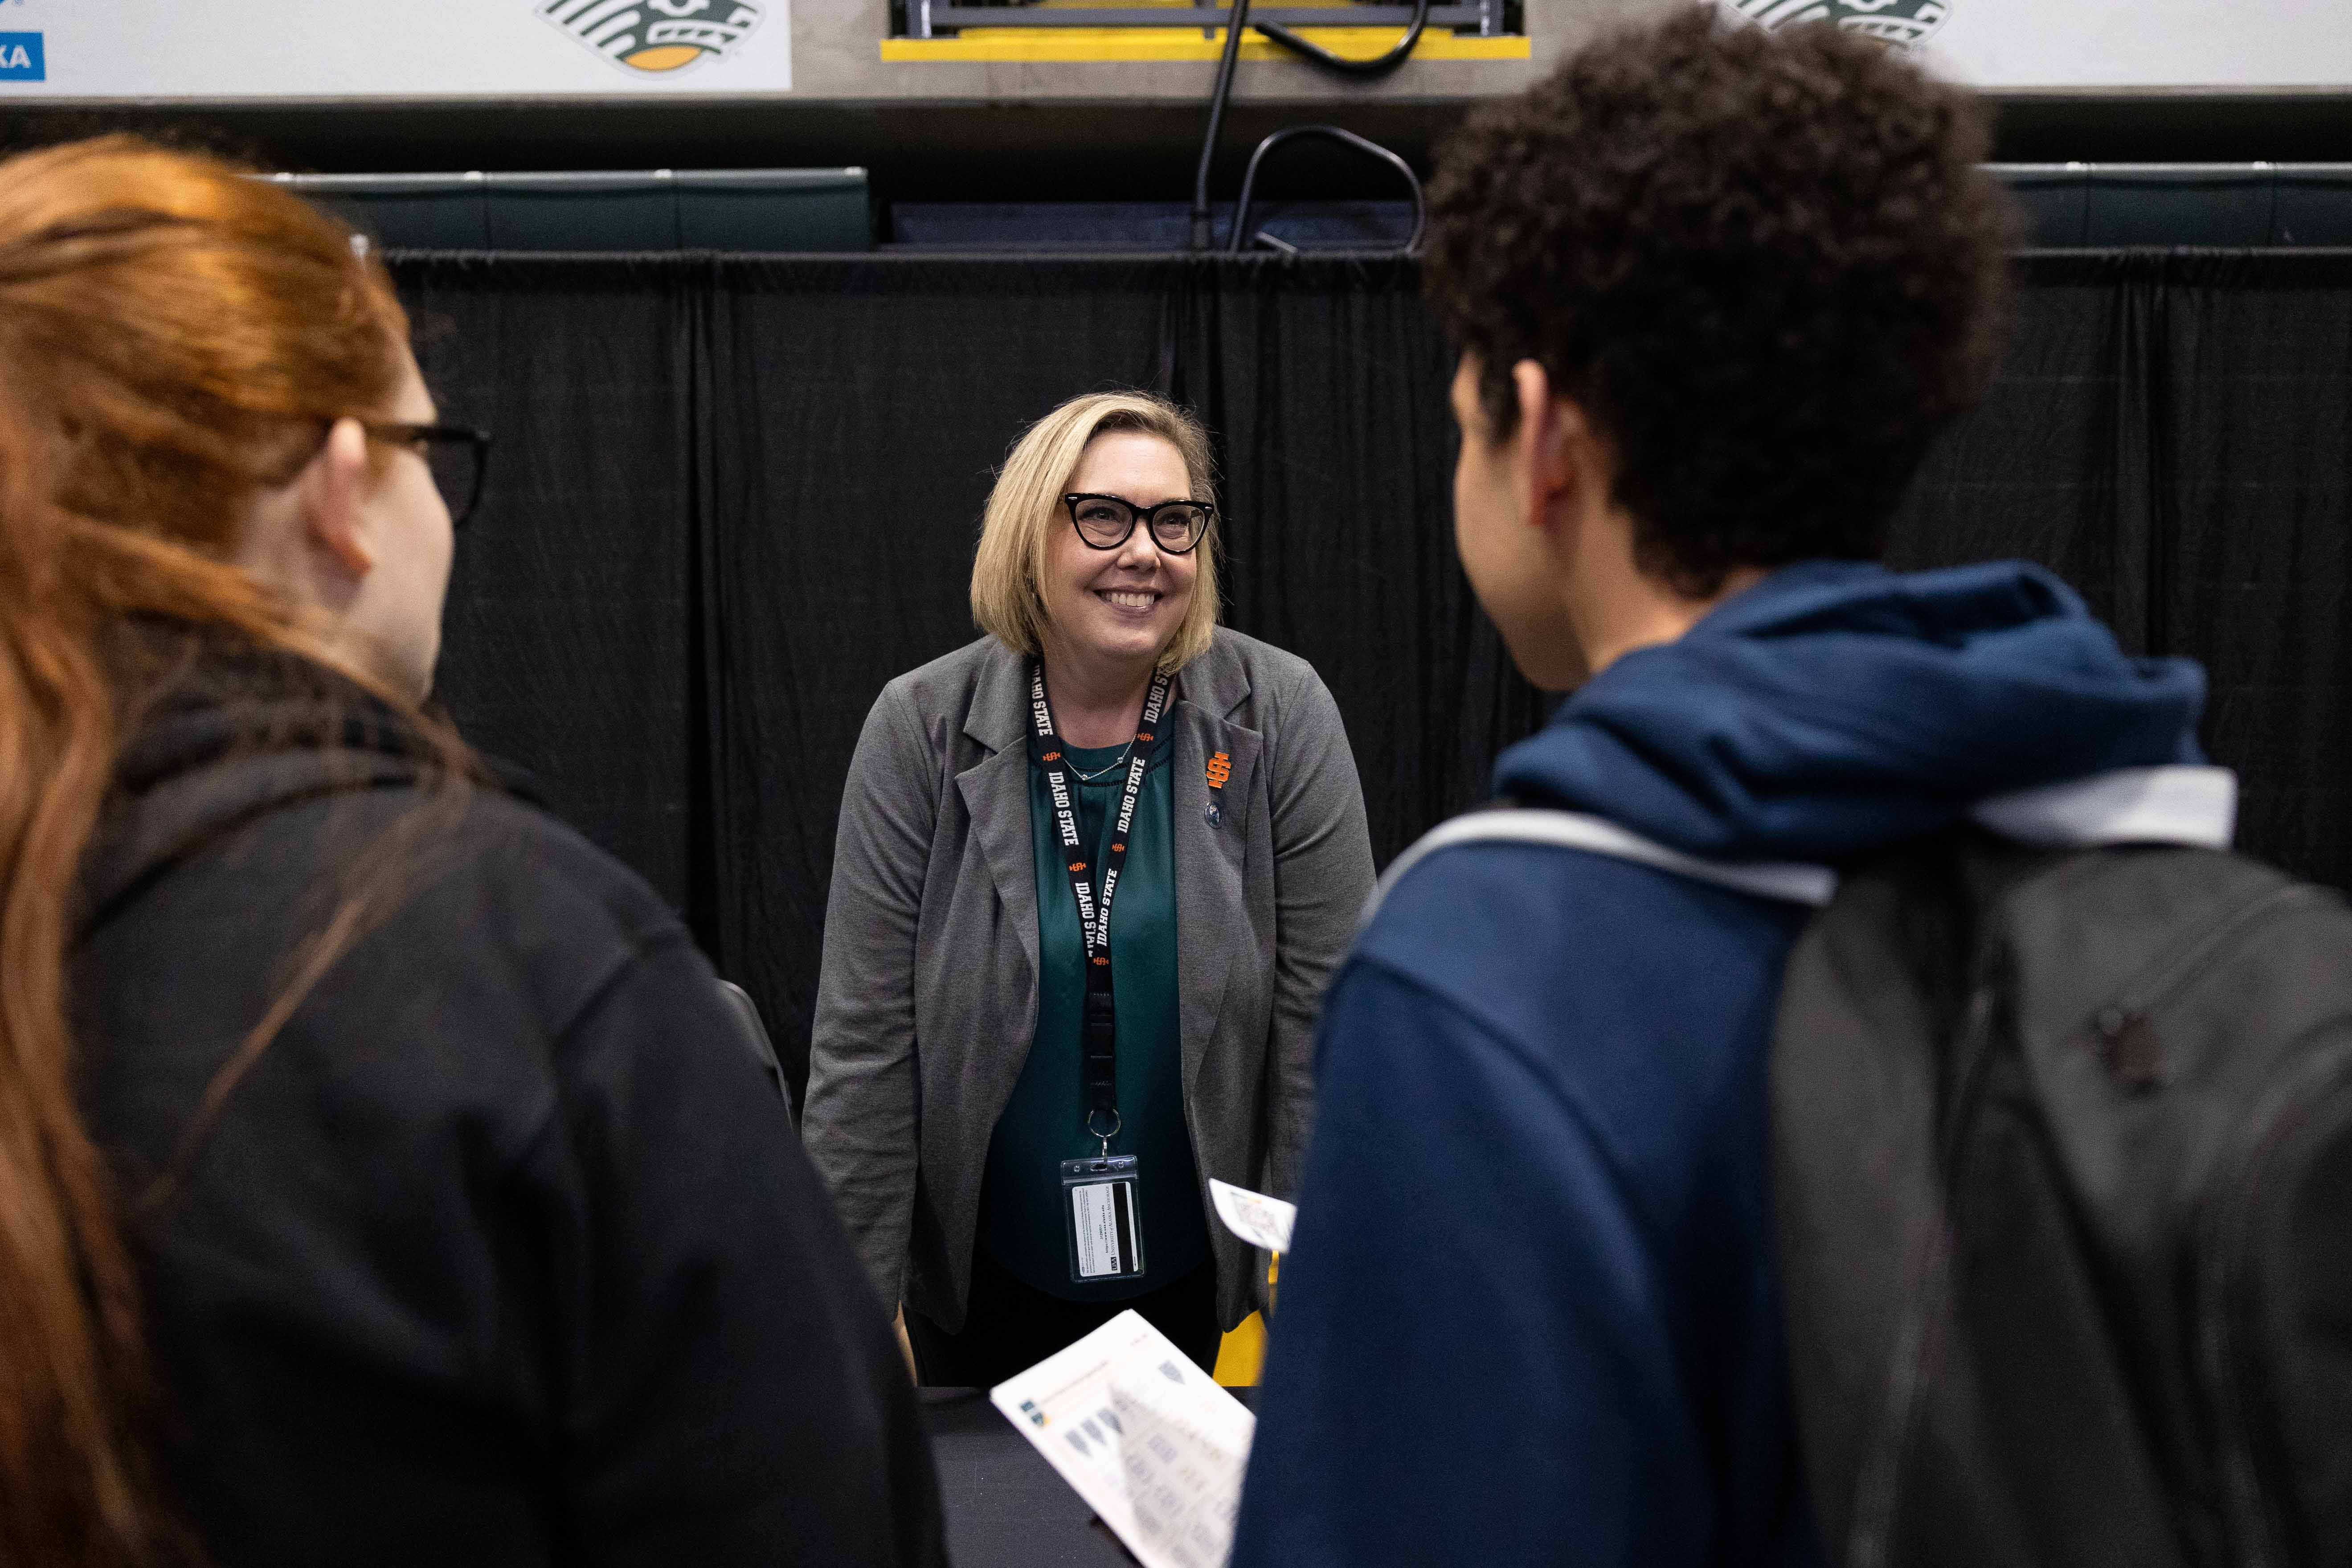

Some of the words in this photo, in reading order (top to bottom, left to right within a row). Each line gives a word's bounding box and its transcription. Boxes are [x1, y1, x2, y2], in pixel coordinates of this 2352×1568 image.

[1033, 701, 1054, 736] STATE
[1144, 685, 1165, 724] IDAHO
[1048, 772, 1069, 808] IDAHO
[1117, 795, 1135, 833] IDAHO
[1126, 757, 1145, 794] STATE
[1058, 810, 1079, 846] STATE
[1075, 882, 1095, 919] IDAHO
[1102, 868, 1117, 906] STATE
[1097, 908, 1109, 946] IDAHO
